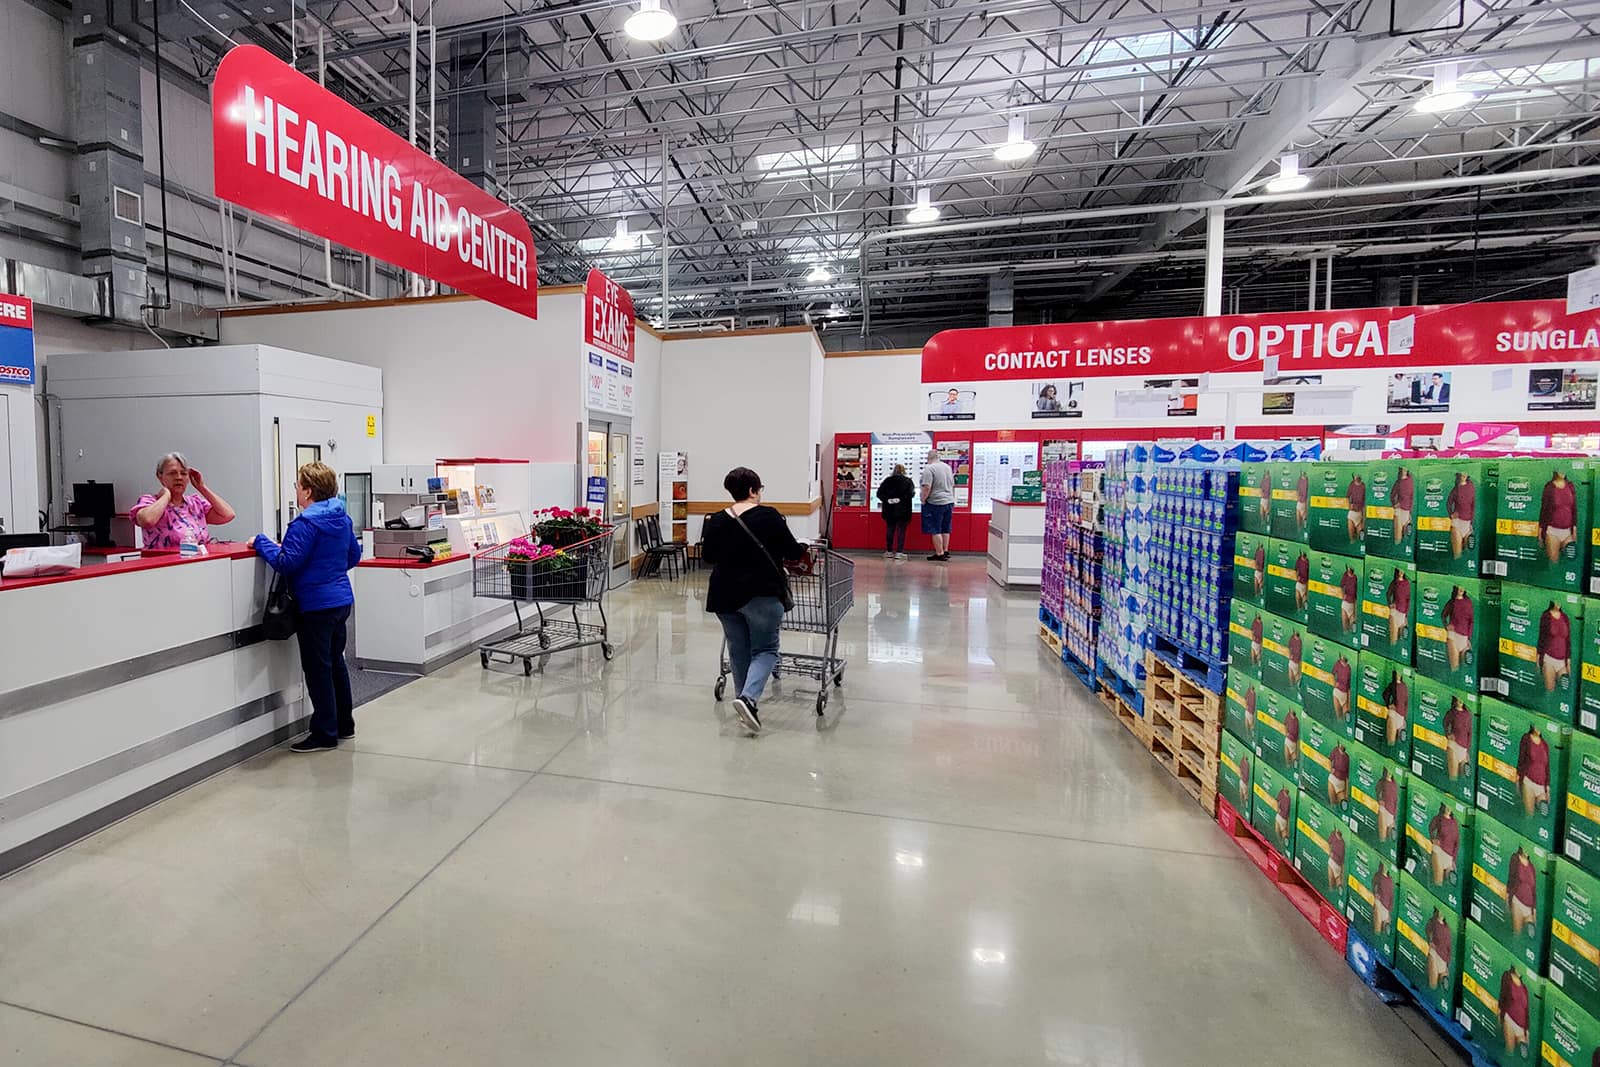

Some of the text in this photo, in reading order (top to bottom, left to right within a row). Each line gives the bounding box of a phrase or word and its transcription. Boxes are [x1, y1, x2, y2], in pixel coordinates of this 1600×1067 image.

[245, 85, 527, 290] HEARING AID CENTER
[606, 280, 619, 308] EYE
[0, 303, 26, 320] RE
[593, 295, 630, 351] EXAMS
[1496, 328, 1600, 352] SUNGLA
[985, 346, 1151, 371] CONTACT LENSES
[1508, 482, 1528, 491] Depend
[1565, 571, 1576, 581] 80
[1501, 641, 1509, 650] XL
[1586, 665, 1596, 678] XL
[1560, 702, 1570, 713] 80
[1571, 797, 1581, 810] XL
[1567, 886, 1588, 905] Depend
[1562, 898, 1593, 922] PROTECTION
[1554, 1011, 1577, 1033] Depend
